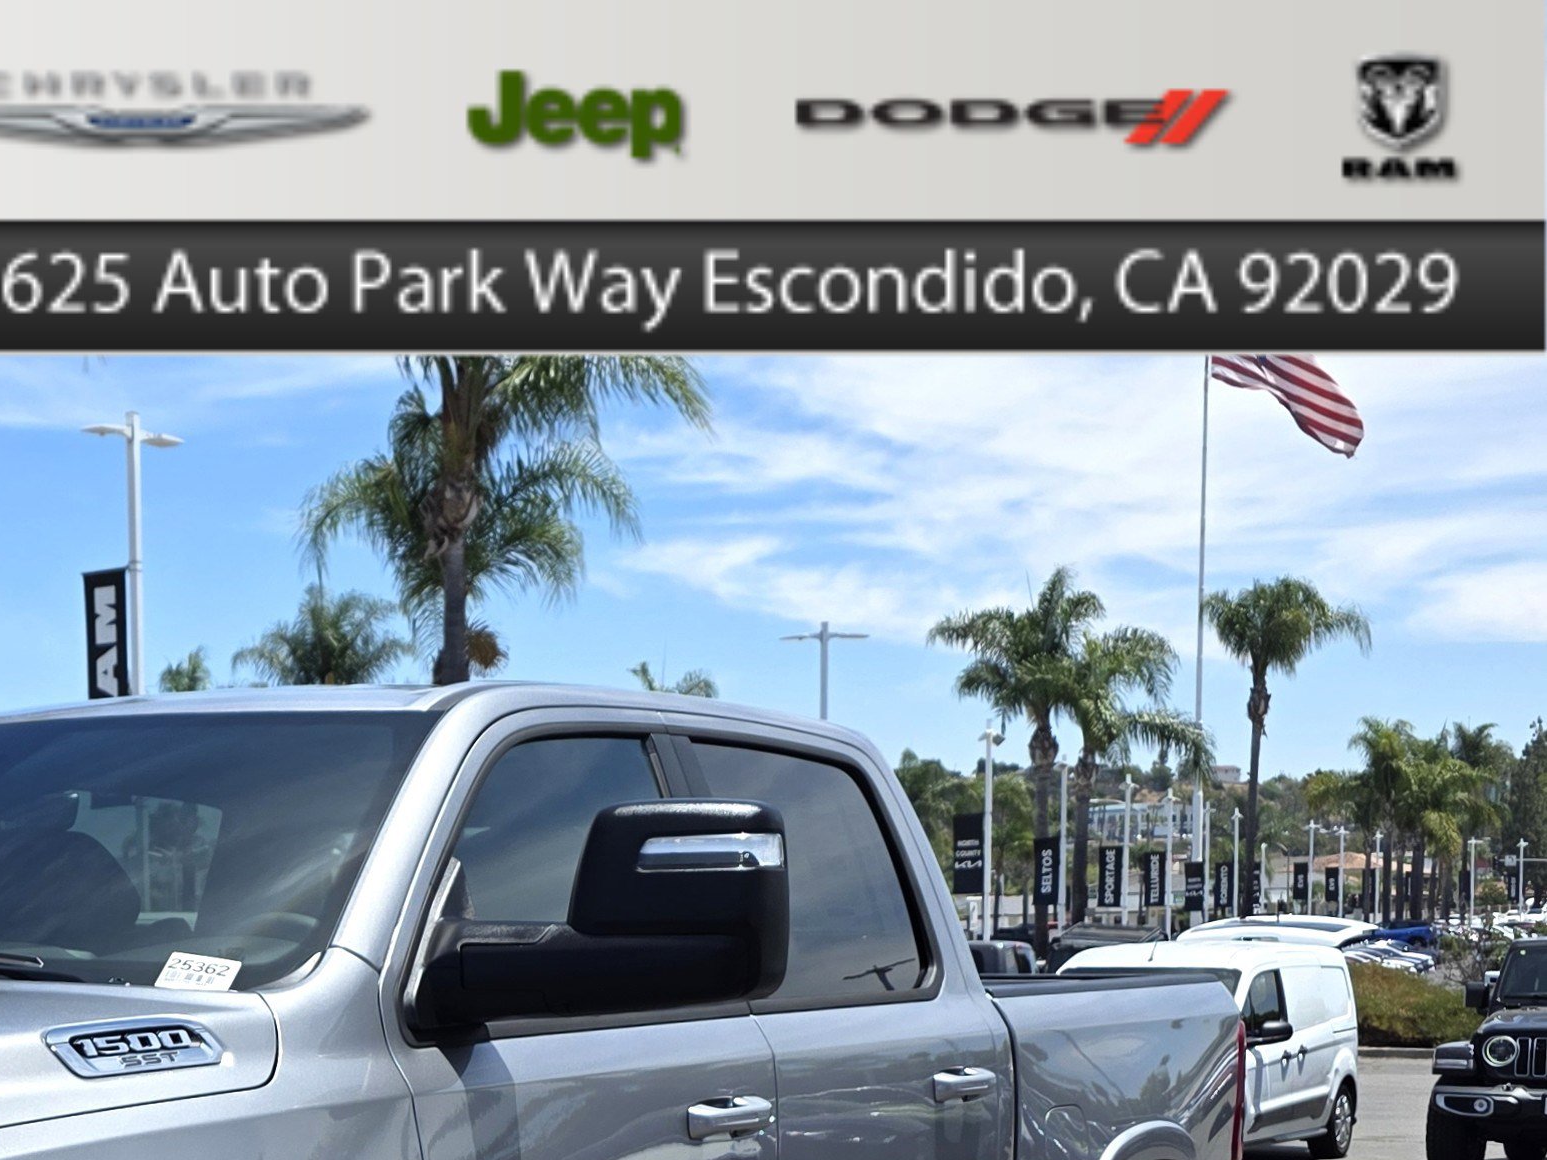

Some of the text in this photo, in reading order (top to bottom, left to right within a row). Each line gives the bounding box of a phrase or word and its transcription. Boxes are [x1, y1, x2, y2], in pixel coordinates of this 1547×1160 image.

[93, 584, 119, 697] AM
[1041, 848, 1053, 894] SELTOS
[1104, 849, 1116, 905] SPORTAGE
[1150, 854, 1160, 904] TELLURIDE
[167, 958, 231, 977] 25362
[73, 1028, 193, 1057] 1500
[121, 1051, 179, 1067] SST
